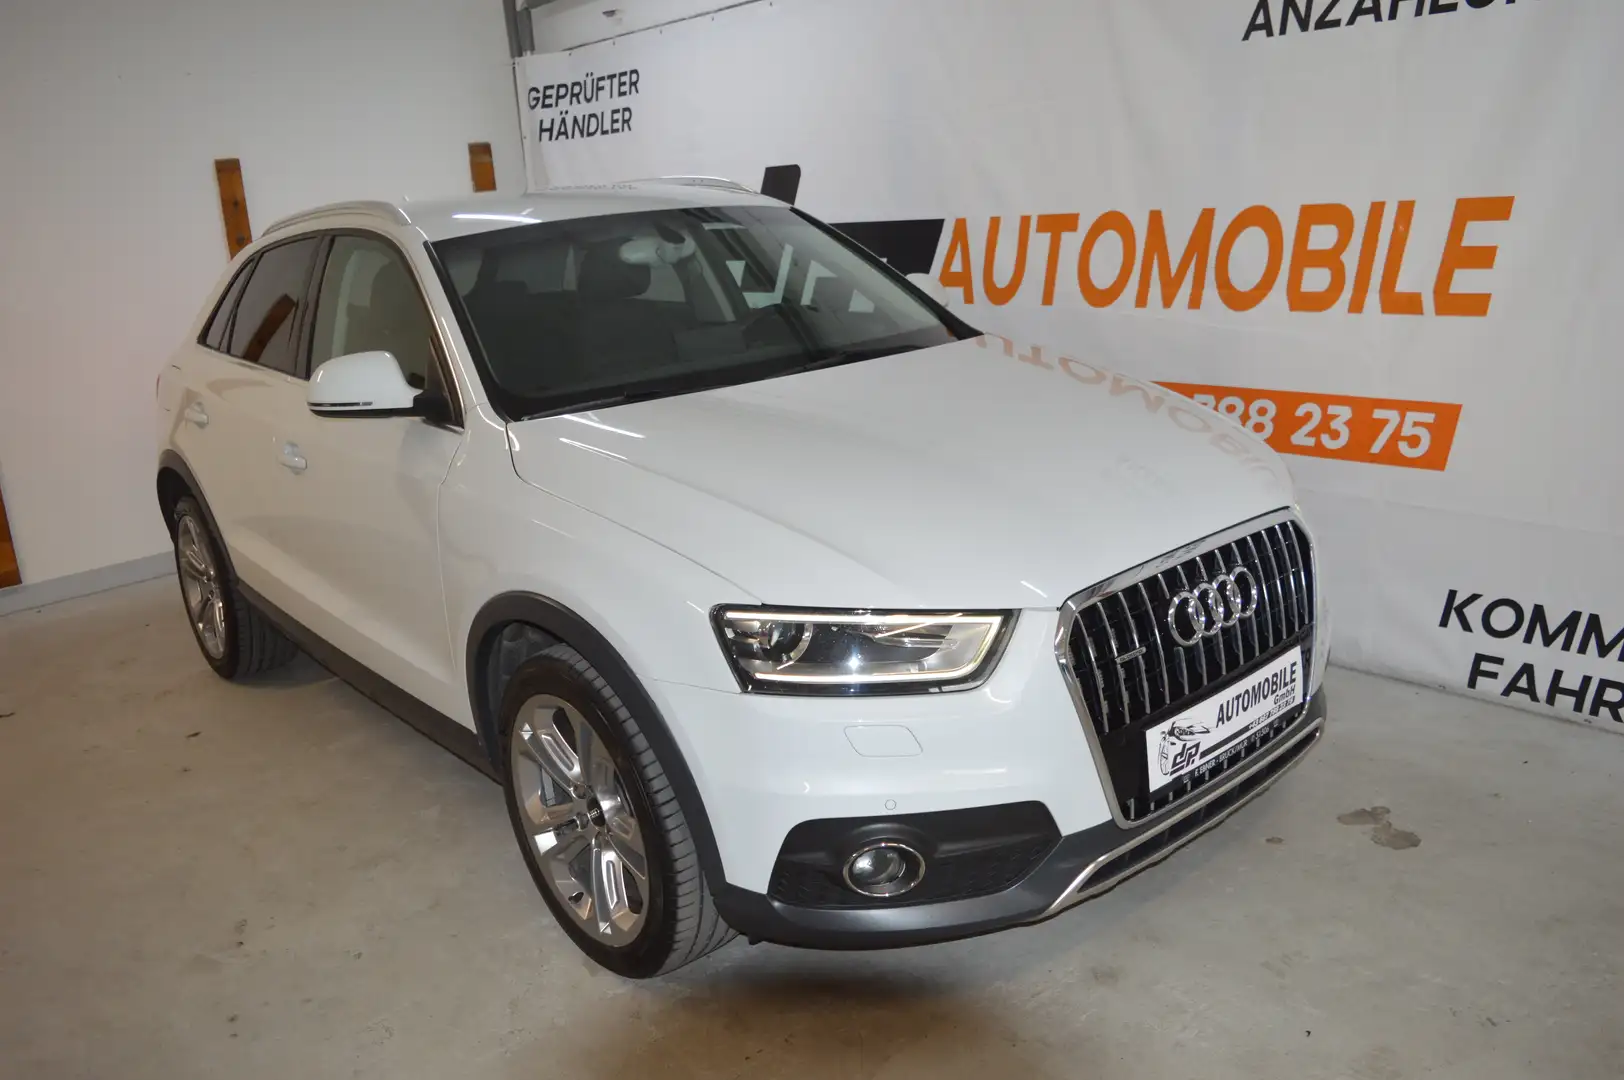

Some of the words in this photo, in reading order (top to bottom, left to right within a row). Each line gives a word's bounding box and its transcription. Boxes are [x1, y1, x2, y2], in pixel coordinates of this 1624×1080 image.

[527, 69, 640, 110] GEPRÜFTER
[539, 107, 633, 142] HÄNDLER
[938, 196, 1515, 317] AUTOMOBILE
[1290, 402, 1353, 450] 23
[1368, 408, 1437, 459] 75
[1216, 661, 1297, 728] AUTOMOBILE
[1273, 684, 1296, 706] GmbH
[1467, 652, 1624, 724] FAHR
